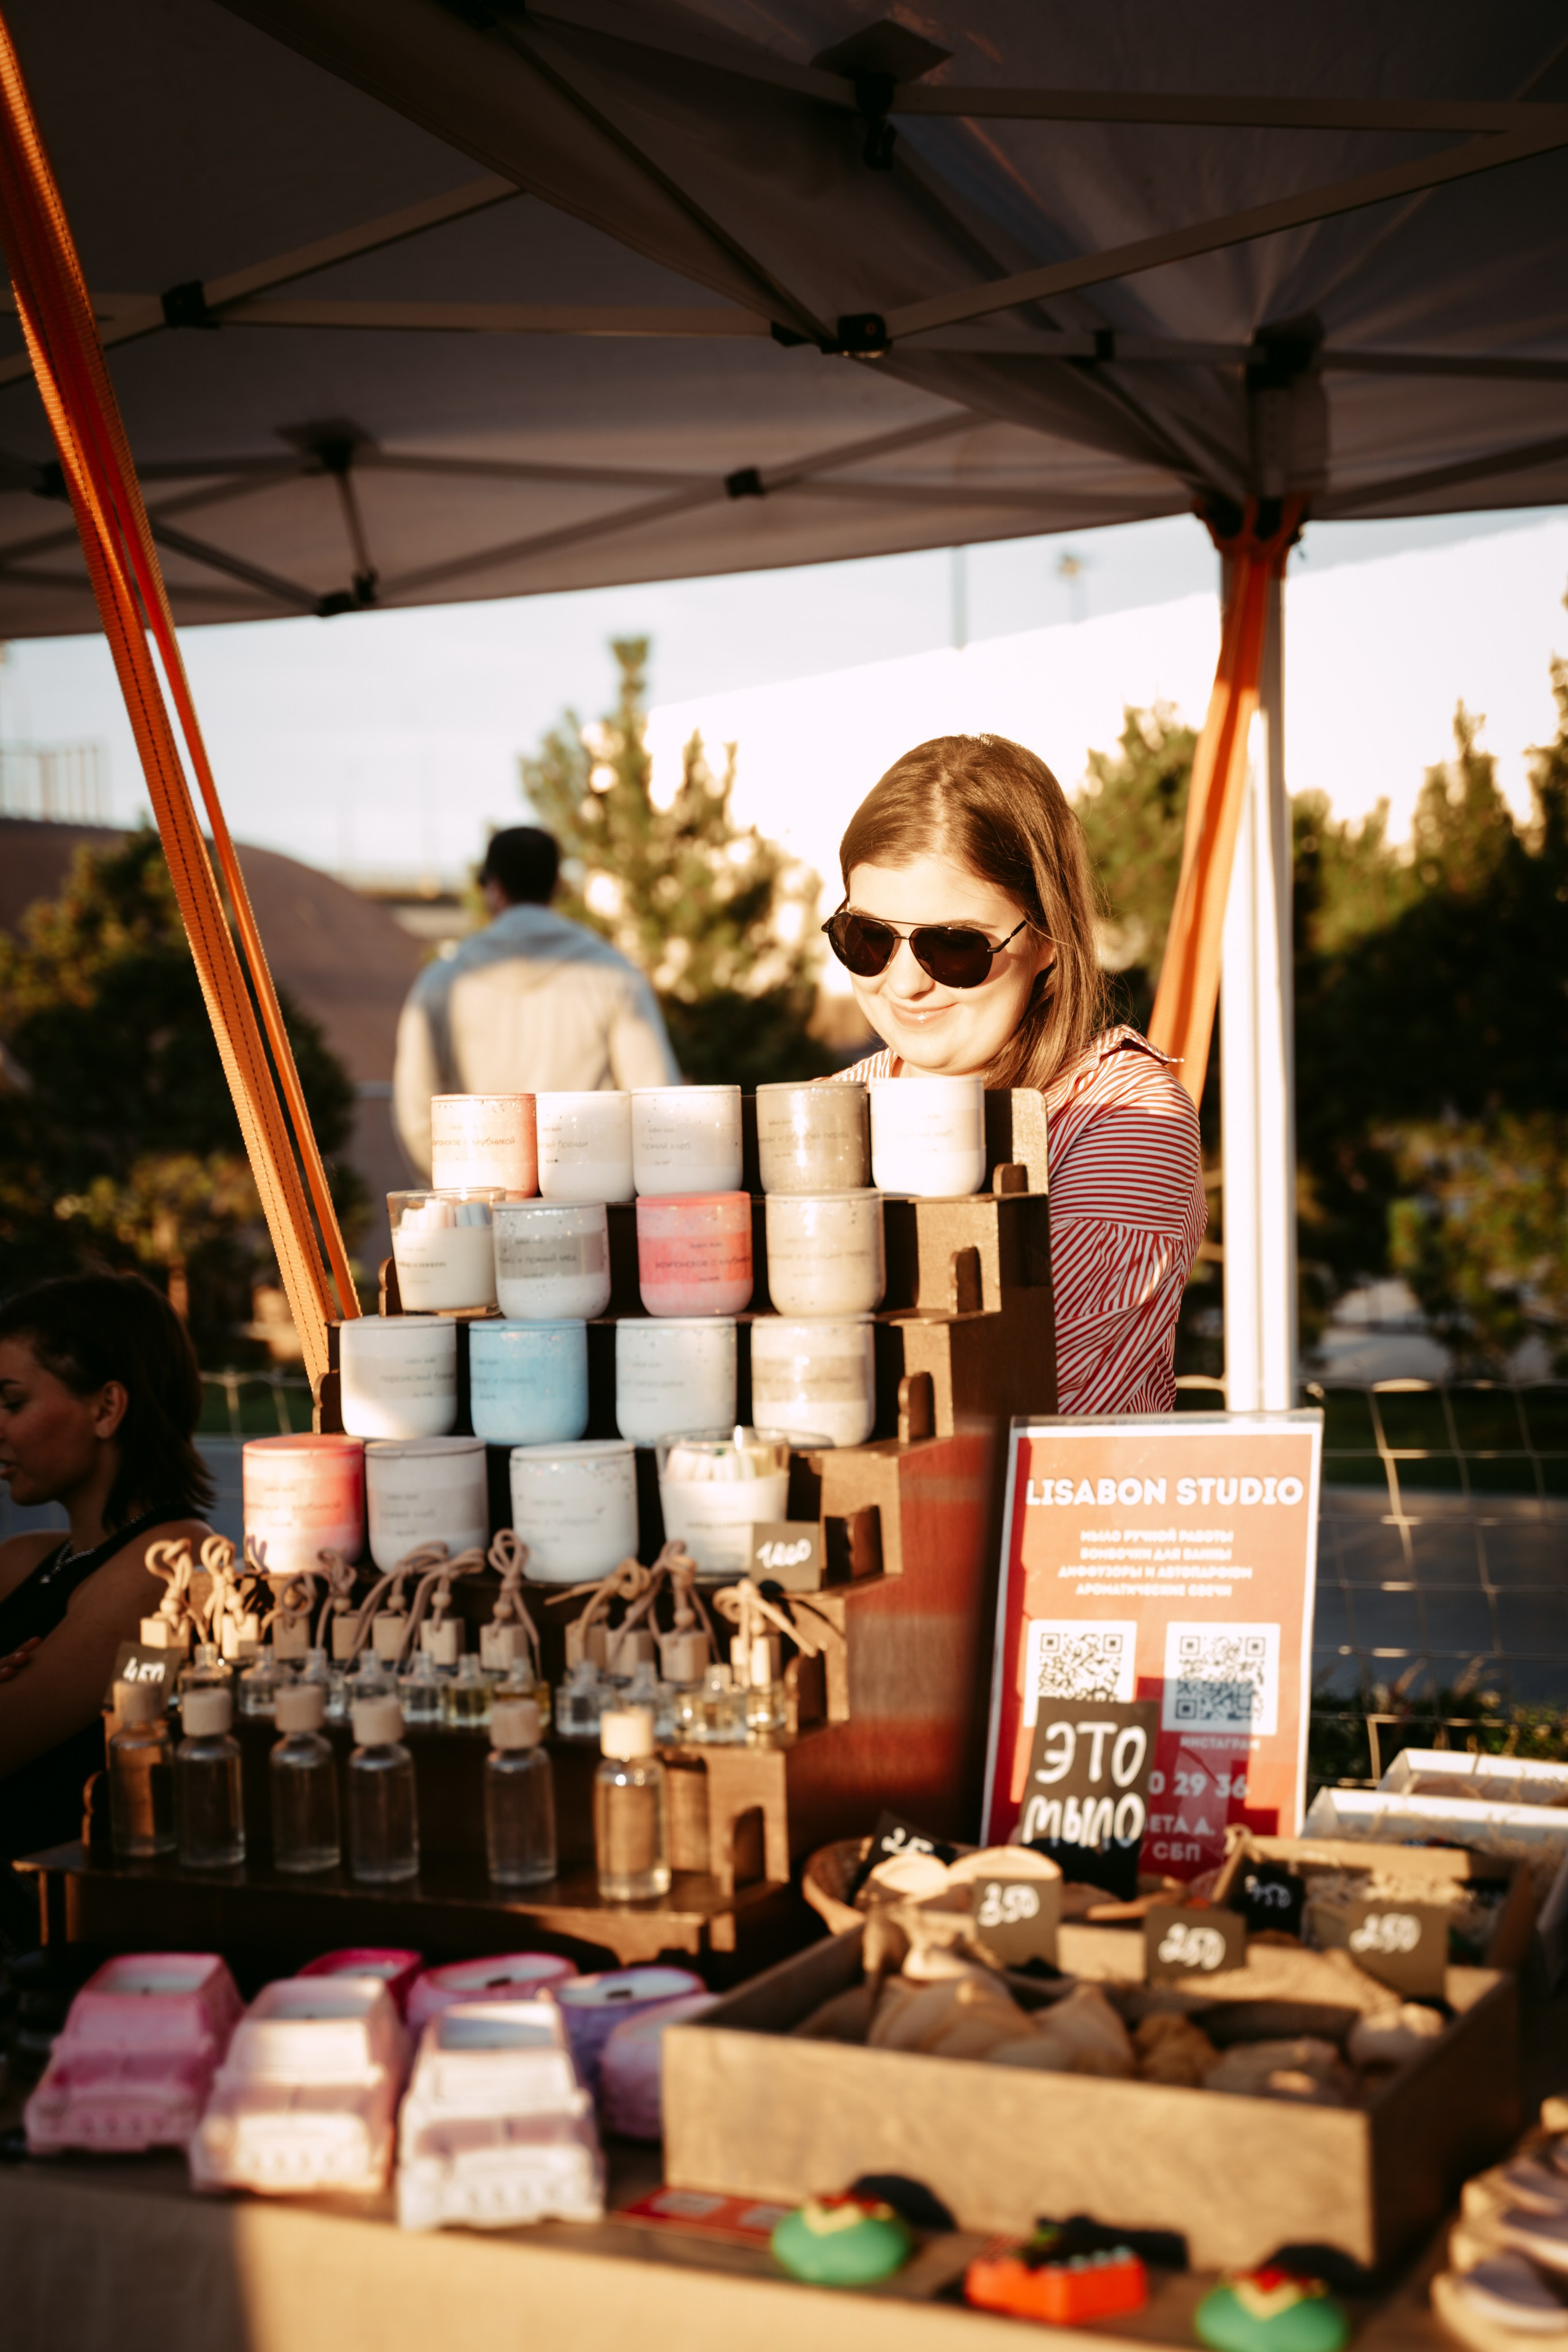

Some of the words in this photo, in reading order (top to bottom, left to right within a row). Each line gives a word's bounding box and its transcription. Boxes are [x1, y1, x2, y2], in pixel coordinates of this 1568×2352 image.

[1025, 1476, 1167, 1506] LISABON
[1176, 1476, 1304, 1506] STUDIO
[1080, 1529, 1122, 1542] МЫЛО
[1123, 1527, 1177, 1542] РУЧНОЙ
[1178, 1529, 1235, 1543] РАБОТЫ
[1079, 1547, 1153, 1561] БОМБОЧКИ
[1153, 1547, 1181, 1561] ДЛЯ
[1183, 1547, 1232, 1561] ВАННЫ
[1057, 1565, 1143, 1578] ДИФФУЗОРЫ
[1144, 1566, 1155, 1578] И
[1074, 1583, 1186, 1597] АРОМАТИЧЕСКИЕ
[1188, 1583, 1233, 1597] СВЕЧИ
[1180, 1736, 1261, 1751] ИНСТАГРАМ
[1035, 1721, 1147, 1787] ЭТО
[1172, 1771, 1208, 1798] 29
[1214, 1773, 1251, 1800] 36
[1022, 1792, 1145, 1851] МЫЛО
[1145, 1814, 1191, 1834] ЕТА
[1152, 1840, 1201, 1862] СБП
